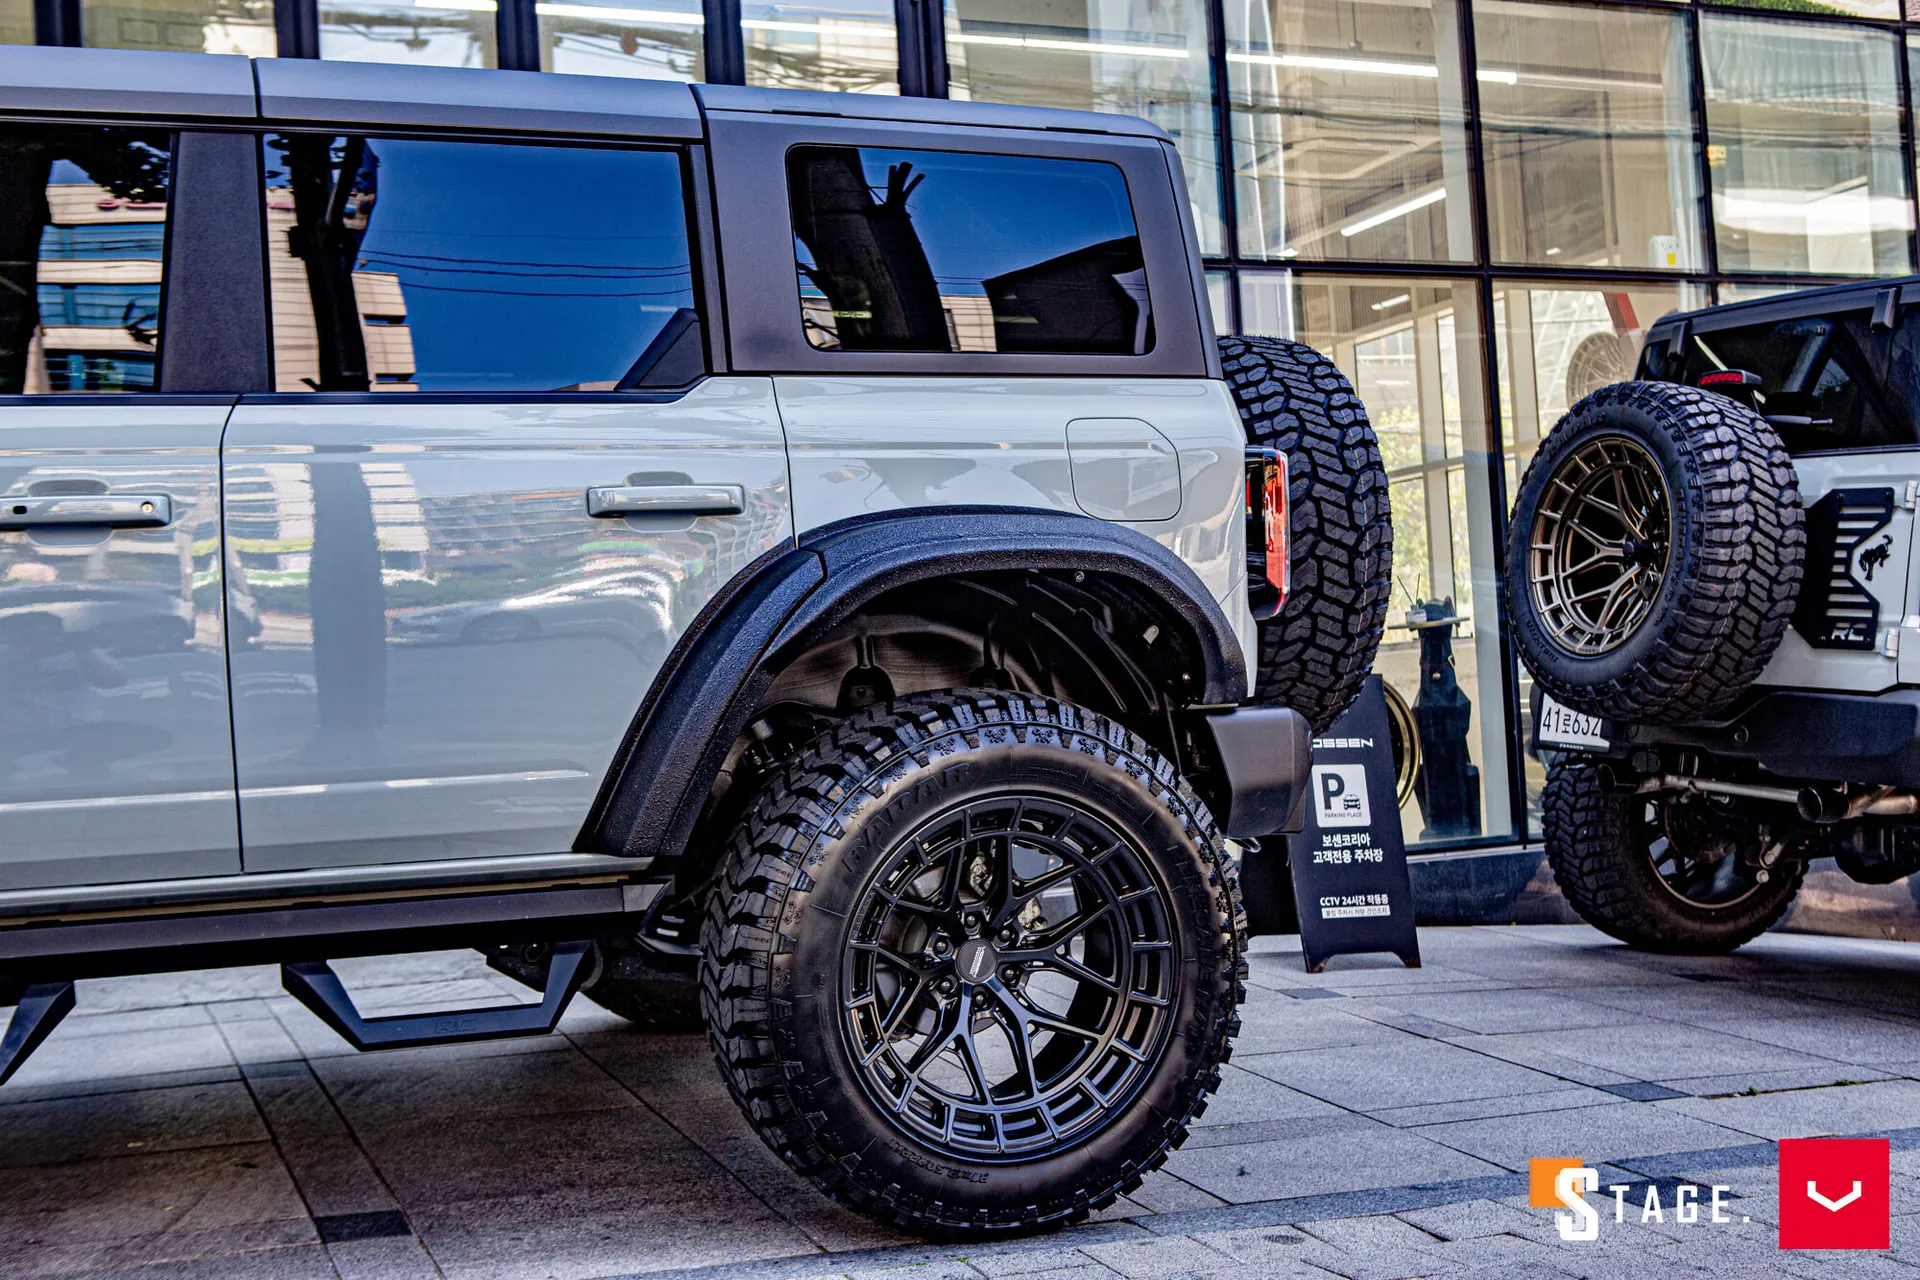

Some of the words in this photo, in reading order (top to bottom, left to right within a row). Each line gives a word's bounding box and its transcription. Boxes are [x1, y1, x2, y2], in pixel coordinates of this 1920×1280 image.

[1321, 773, 1345, 810] P
[1322, 832, 1370, 847] 보센코리아
[1313, 850, 1352, 864] 고객전용
[1354, 848, 1383, 863] 주차장
[1320, 896, 1340, 906] CCTV
[1341, 894, 1366, 906] 24시간
[1367, 893, 1389, 905] 작동중
